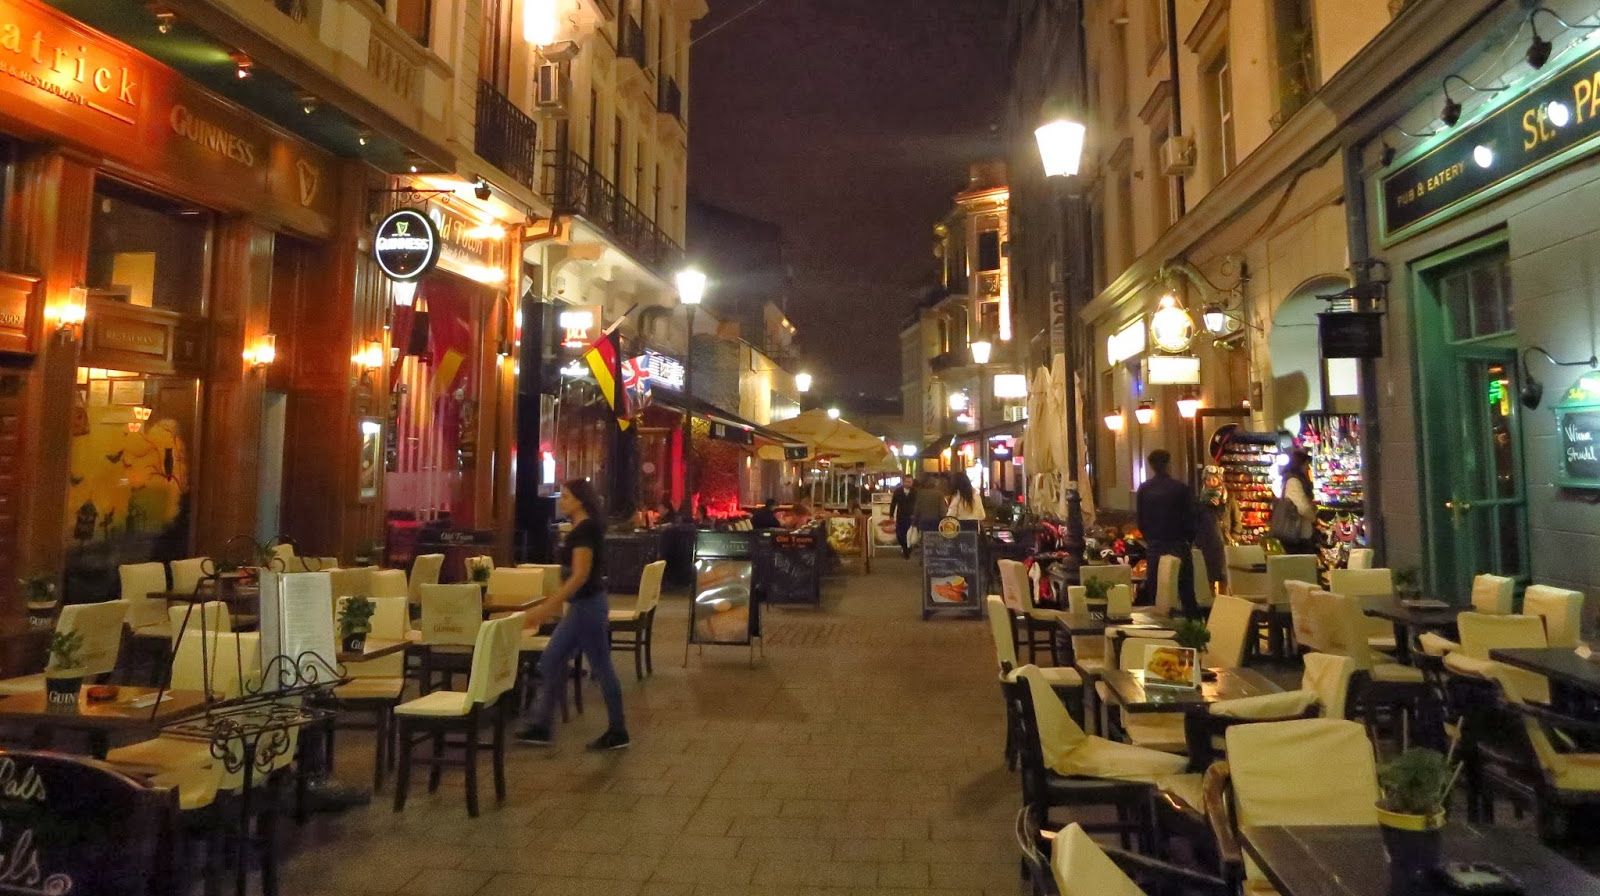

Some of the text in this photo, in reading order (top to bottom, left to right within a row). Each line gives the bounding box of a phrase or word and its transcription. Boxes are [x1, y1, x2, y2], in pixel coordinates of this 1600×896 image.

[170, 104, 254, 168] GUINNESS
[1397, 161, 1466, 207] PUB & EATERY
[454, 220, 482, 255] Town
